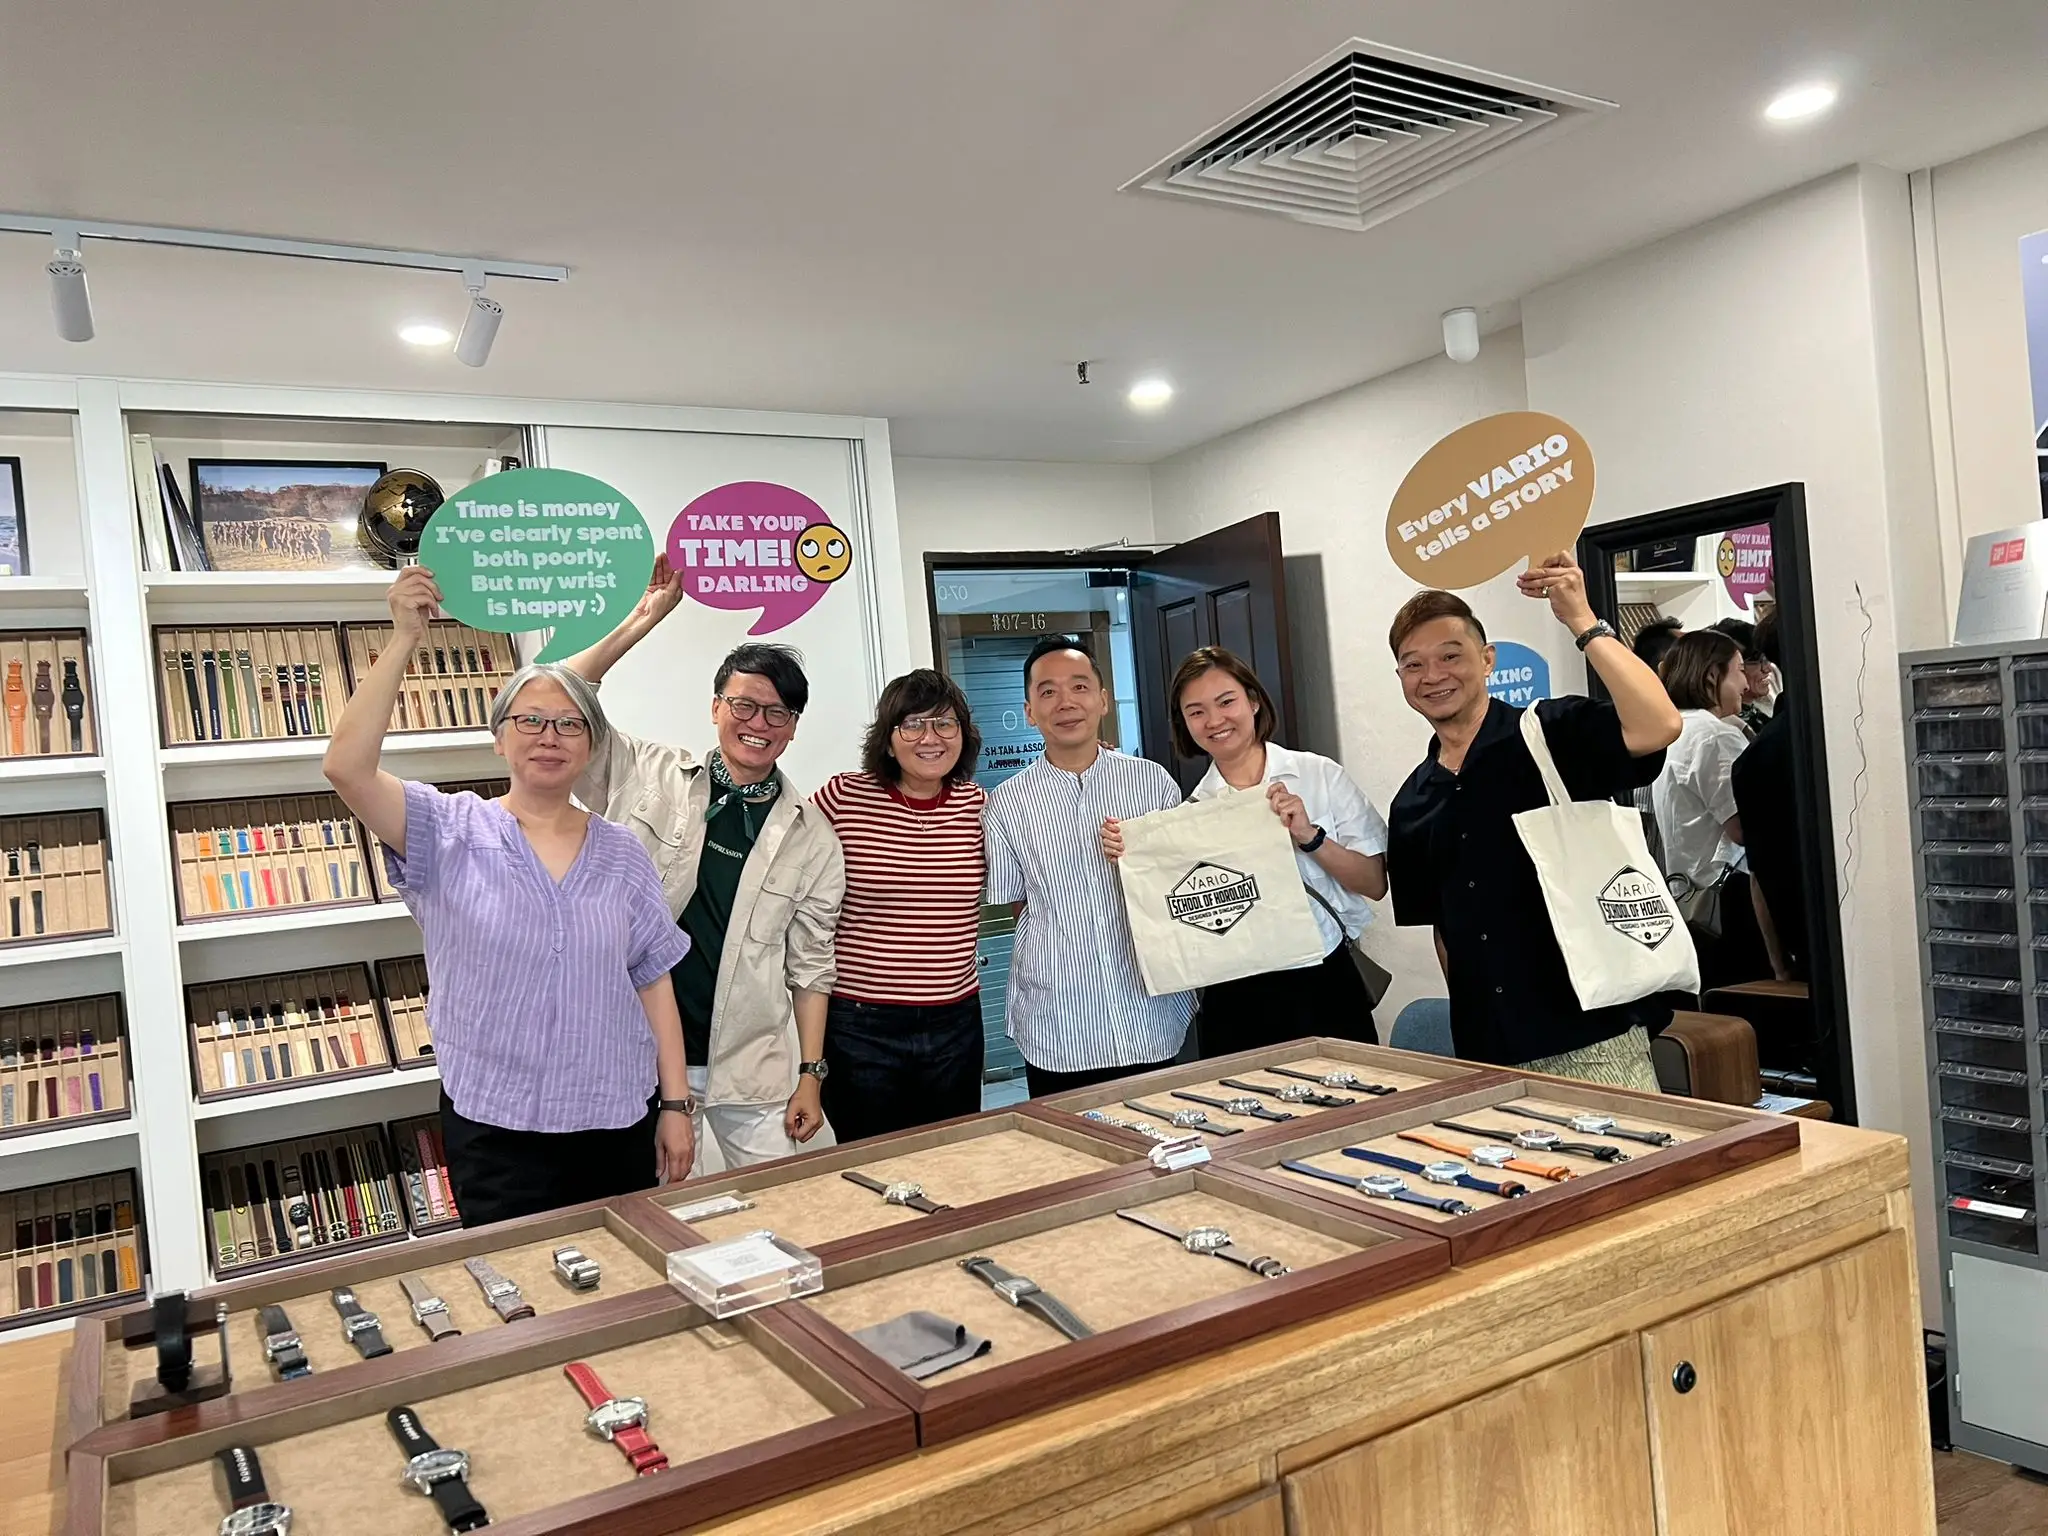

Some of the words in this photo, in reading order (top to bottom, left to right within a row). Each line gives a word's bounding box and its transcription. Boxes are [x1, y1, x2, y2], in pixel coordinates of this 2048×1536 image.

[1397, 493, 1468, 542] Every
[1467, 434, 1568, 499] VARIO
[455, 500, 513, 518] Time
[518, 499, 538, 518] is
[542, 502, 620, 520] money
[1416, 525, 1470, 561] tells
[1472, 513, 1491, 531] a
[1490, 460, 1574, 520] STORY
[687, 515, 743, 531] TAKE
[748, 516, 808, 531] YOUR
[435, 526, 485, 544] I've
[490, 524, 572, 545] clearly
[577, 524, 643, 544] spent
[473, 550, 528, 568] both
[532, 549, 612, 570] poorly.
[679, 539, 792, 567] TIME!
[472, 575, 513, 592] But
[518, 576, 552, 594] my
[557, 571, 616, 589] wrist
[698, 576, 808, 593] DARLING
[487, 598, 508, 616] is
[512, 598, 586, 618] happy
[992, 613, 1046, 630] #07-16
[1485, 666, 1533, 686] KING
[1509, 686, 1533, 702] MY
[985, 746, 996, 756] SH
[998, 745, 1013, 755] TAN
[1187, 873, 1229, 890] VARIO
[1613, 882, 1655, 897] VARIO
[1172, 896, 1203, 914] SCHOOL
[1202, 894, 1214, 907] OF
[1214, 880, 1254, 904] HOROLOGY
[1629, 904, 1639, 917] OF
